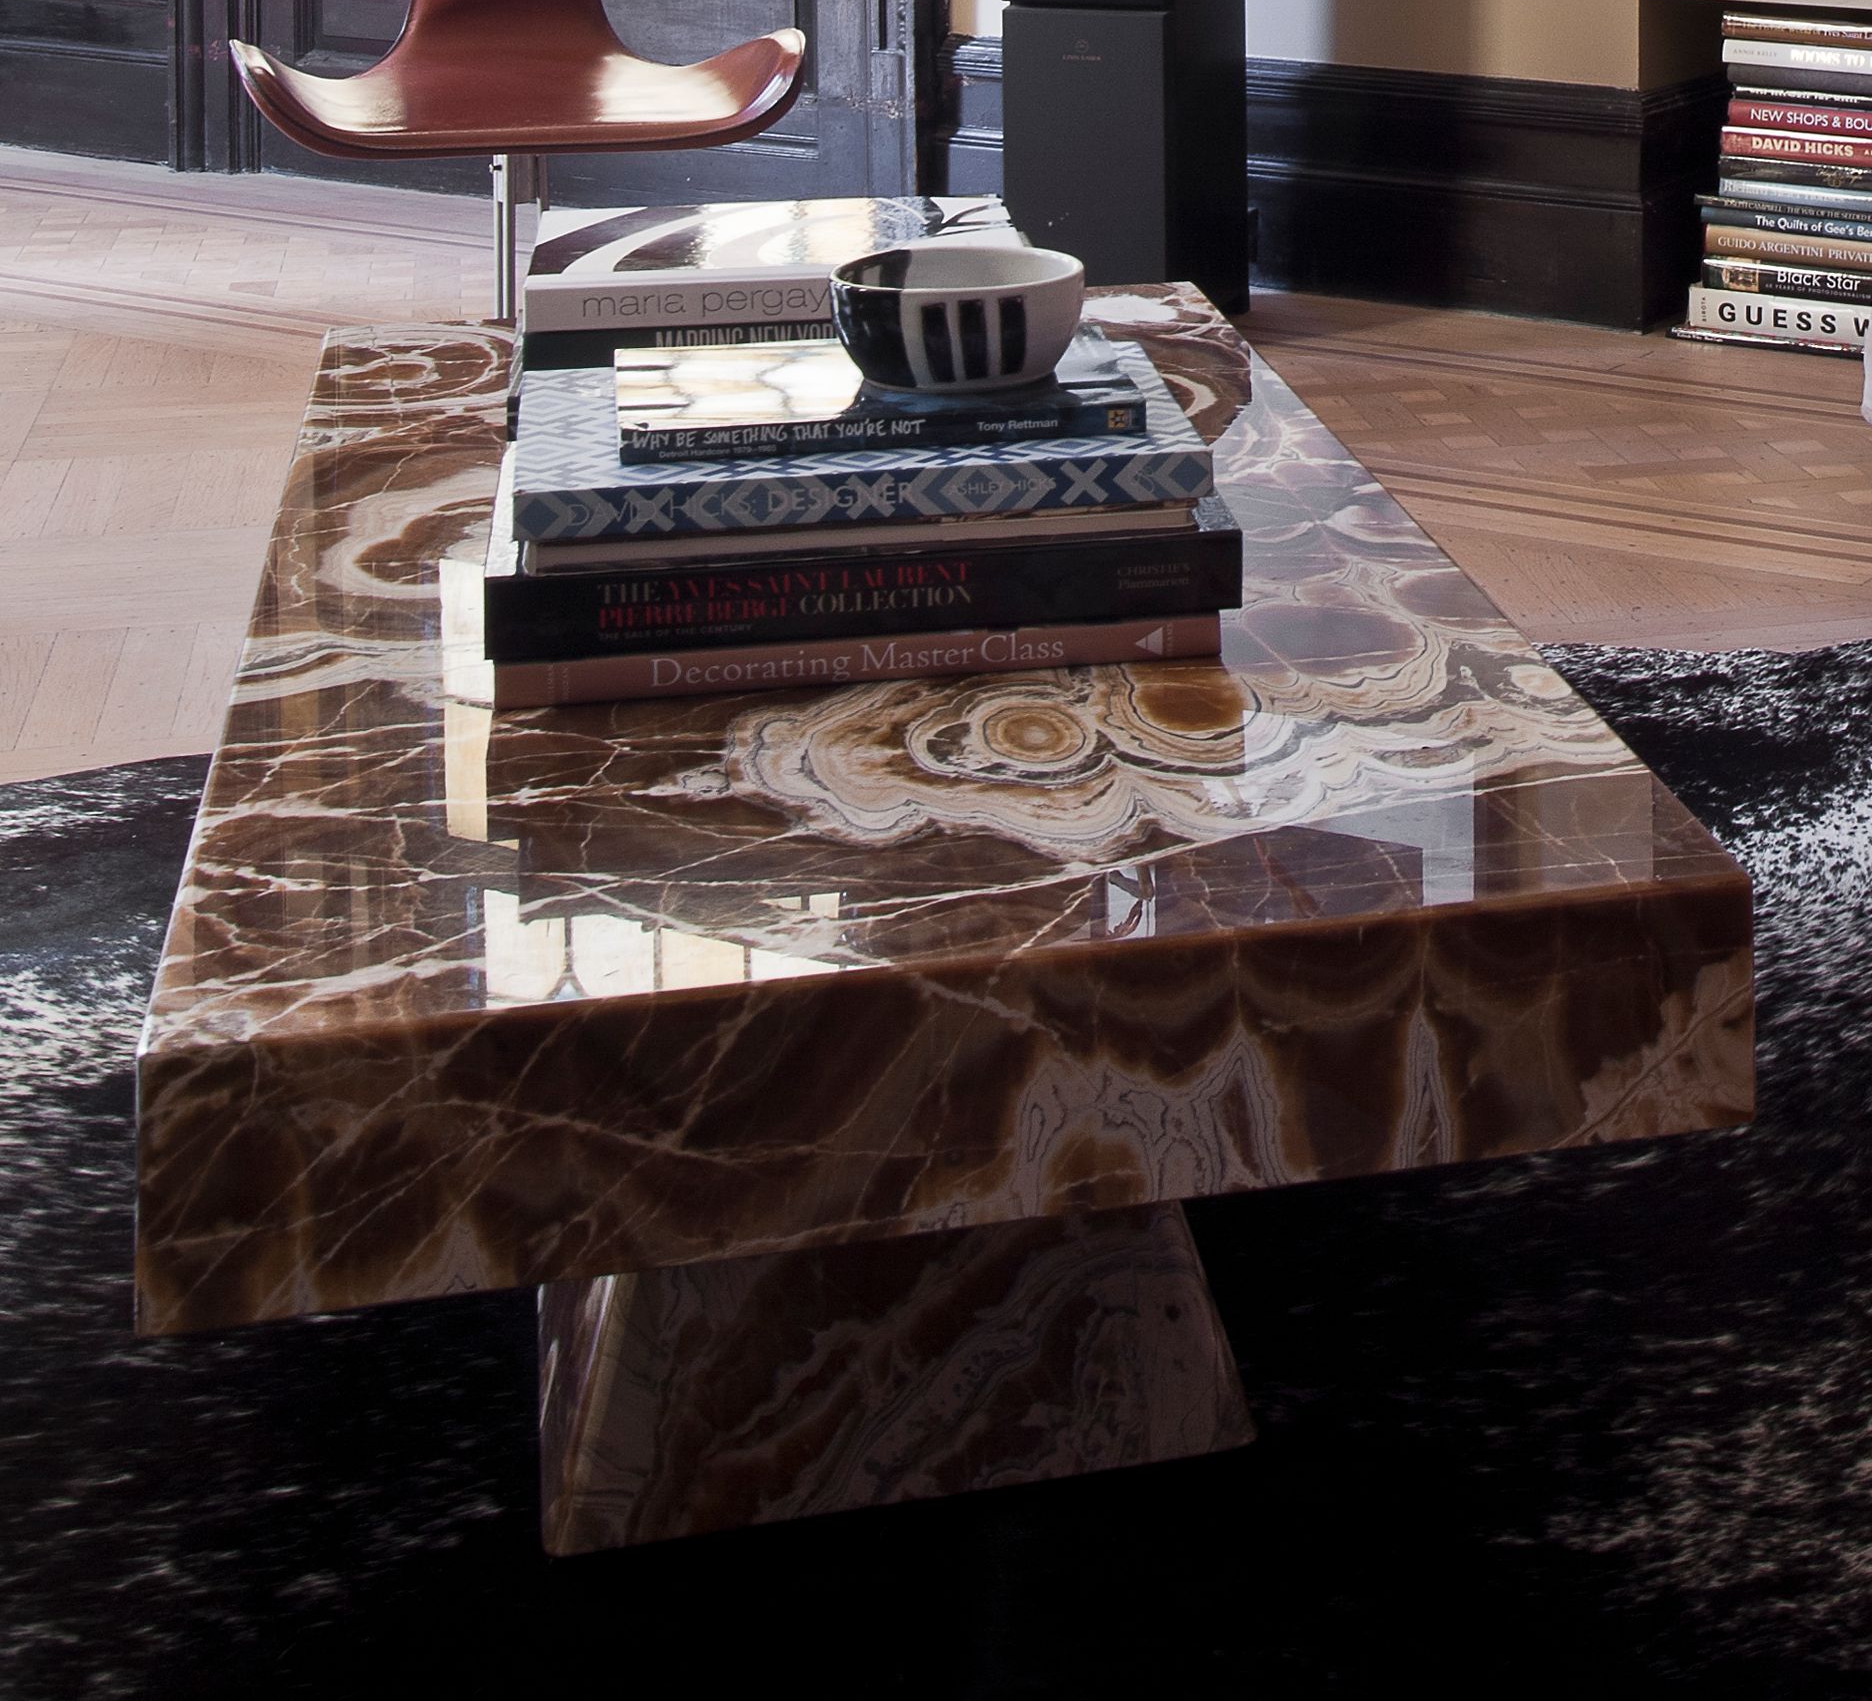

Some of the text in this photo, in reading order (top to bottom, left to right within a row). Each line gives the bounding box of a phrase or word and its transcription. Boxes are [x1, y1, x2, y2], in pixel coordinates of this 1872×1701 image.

[1750, 109, 1784, 123] NEW
[1786, 111, 1828, 126] SHOPS
[1832, 116, 1841, 127] &
[1751, 138, 1853, 156] DAVID HICKS
[1755, 215, 1775, 226] The
[1777, 217, 1808, 232] Quilts
[1811, 221, 1822, 232] of
[1825, 222, 1853, 236] Gee's
[1718, 236, 1756, 249] GUIDO
[1759, 241, 1823, 257] ARGENTINI
[1776, 270, 1860, 291] Black Star
[582, 287, 829, 317] maria pergay
[1718, 302, 1836, 333] GUESS
[633, 430, 670, 449] WHY
[676, 429, 697, 448] BE
[702, 425, 788, 445] SOMETHING
[793, 424, 829, 440] THAT
[890, 419, 926, 435] NOT
[977, 418, 1058, 433] Tony Rettman
[569, 482, 912, 527] DAVID HICKS: DESIGNER
[652, 633, 1064, 687] Decorating Master Class
